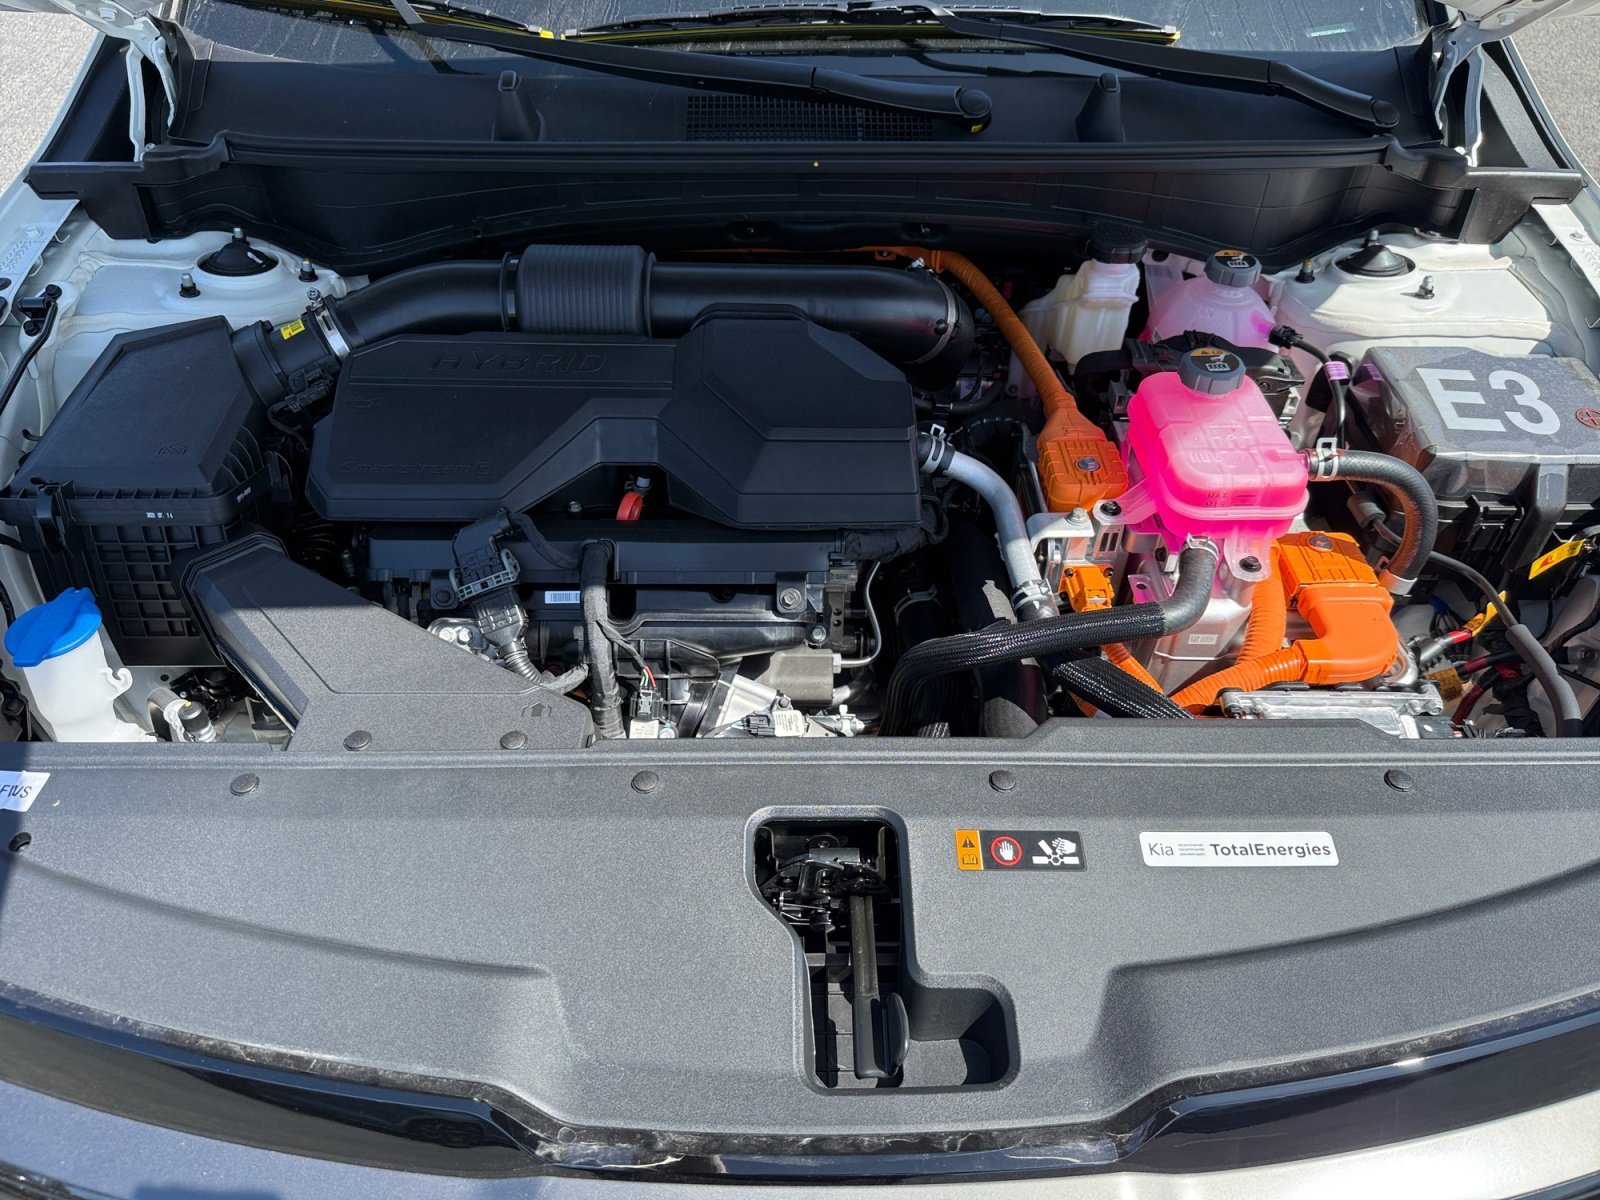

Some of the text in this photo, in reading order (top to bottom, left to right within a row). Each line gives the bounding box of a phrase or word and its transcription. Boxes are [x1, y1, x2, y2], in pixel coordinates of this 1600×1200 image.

[428, 351, 608, 374] HYBRID
[1416, 367, 1561, 435] E3
[1148, 842, 1174, 856] Kia
[1209, 842, 1331, 858] TotalEnergies
